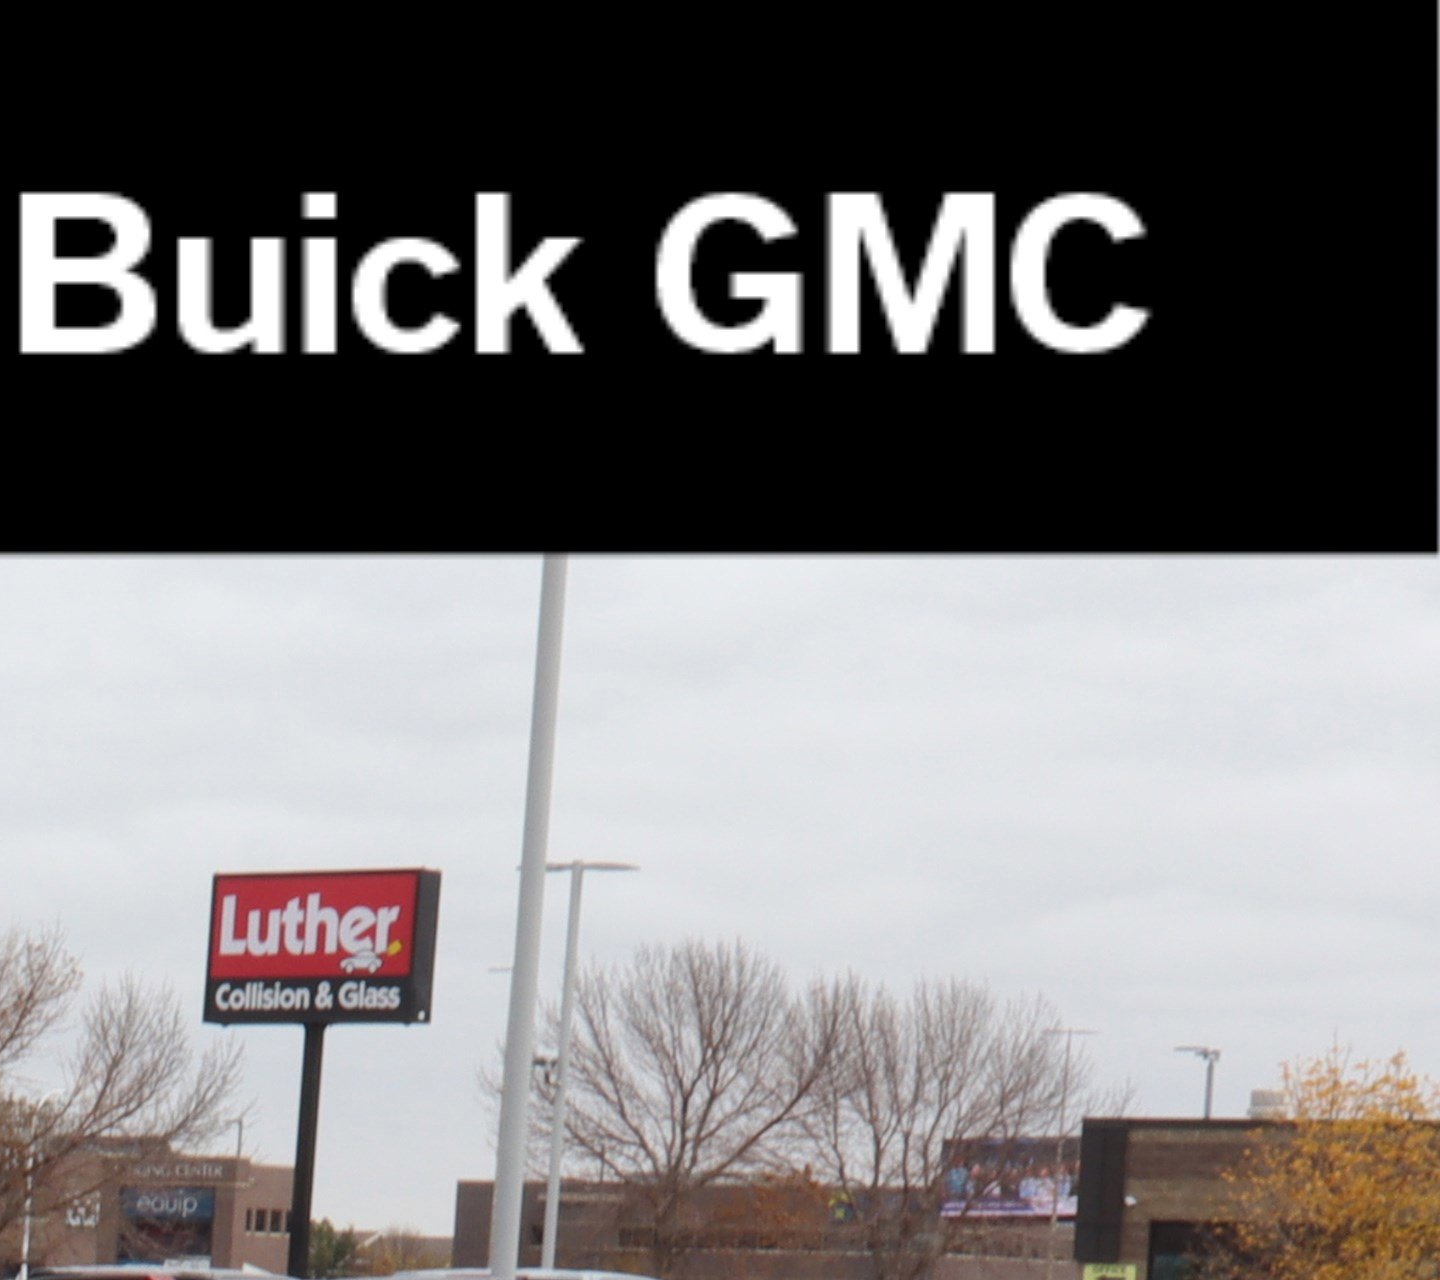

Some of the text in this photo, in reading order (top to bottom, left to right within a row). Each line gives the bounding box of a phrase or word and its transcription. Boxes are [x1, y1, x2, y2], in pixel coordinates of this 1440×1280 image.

[219, 893, 401, 956] Luther
[214, 980, 401, 1011] Collision & Glass
